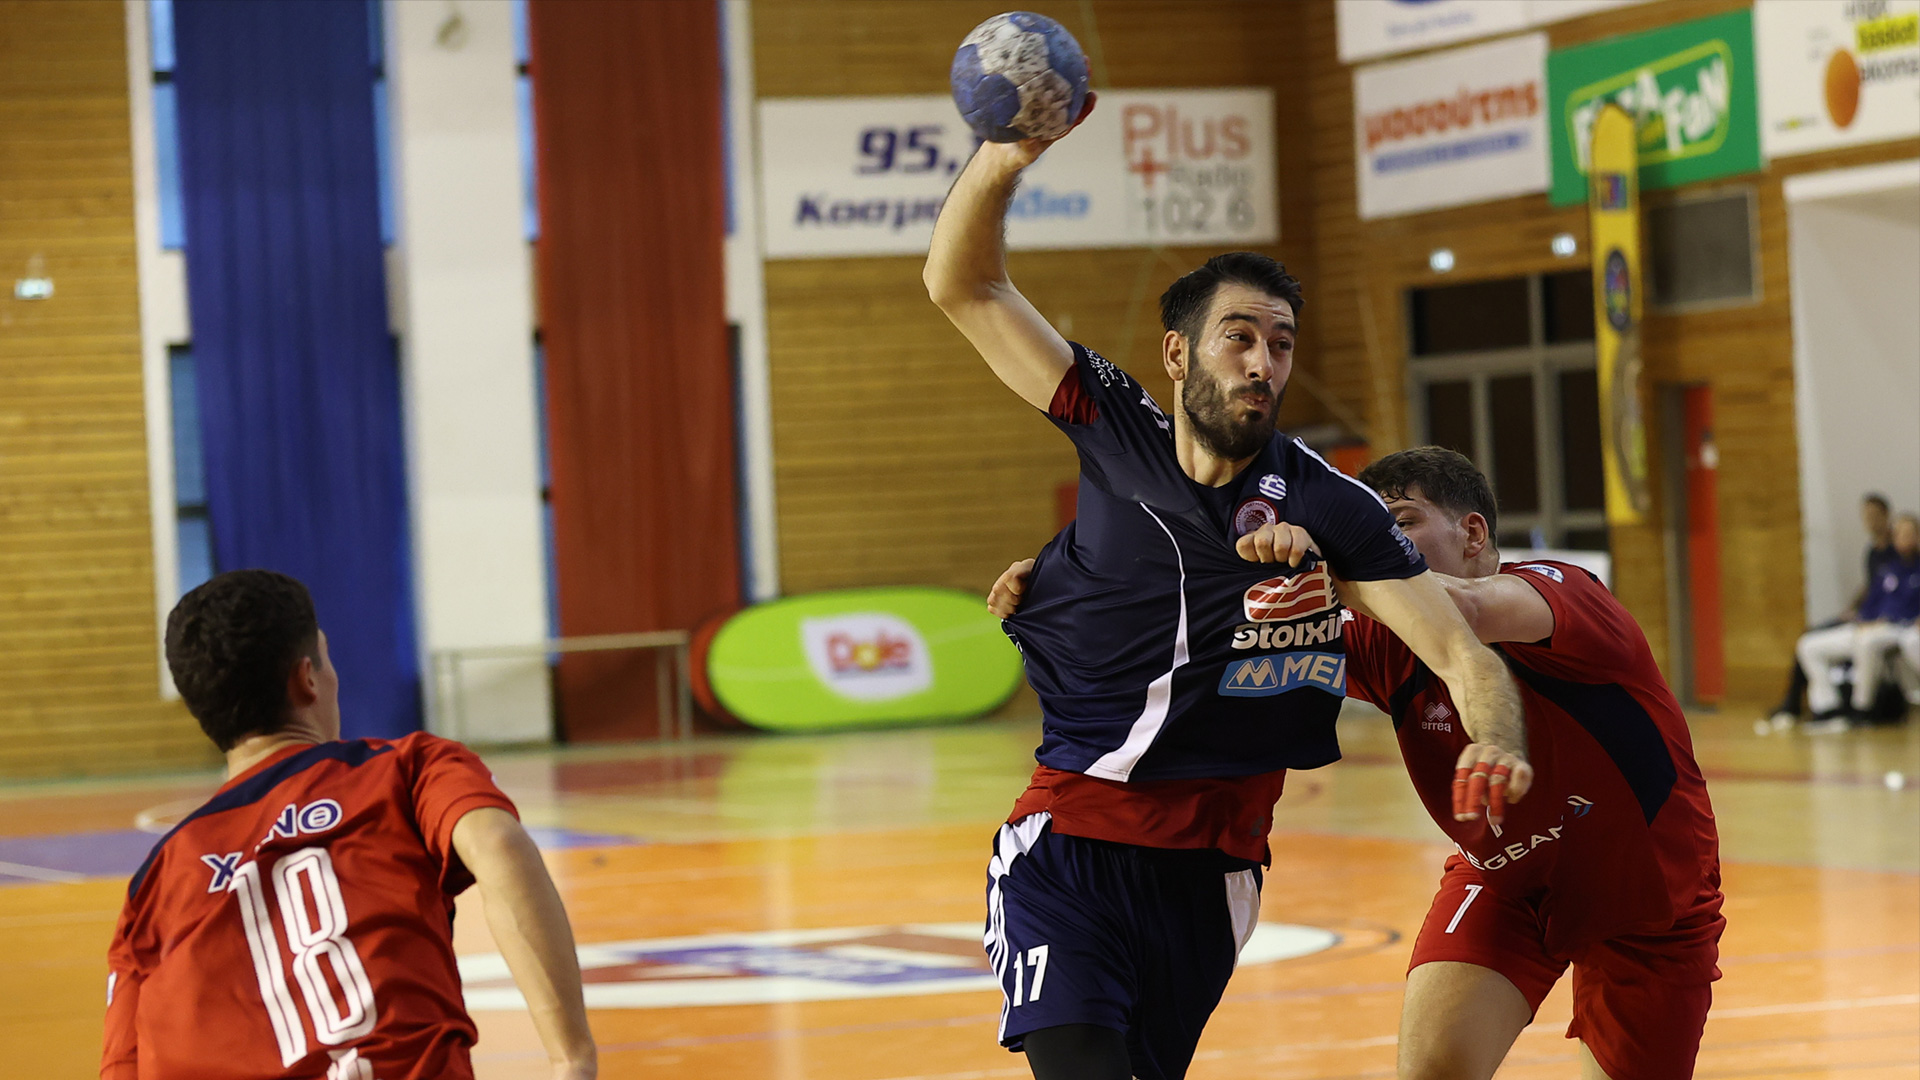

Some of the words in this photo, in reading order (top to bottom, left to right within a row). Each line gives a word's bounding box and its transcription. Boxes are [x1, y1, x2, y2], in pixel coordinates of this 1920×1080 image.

[857, 126, 986, 175] 95,
[1121, 103, 1251, 160] Plus
[228, 847, 378, 1068] 18
[1013, 944, 1049, 1008] 17
